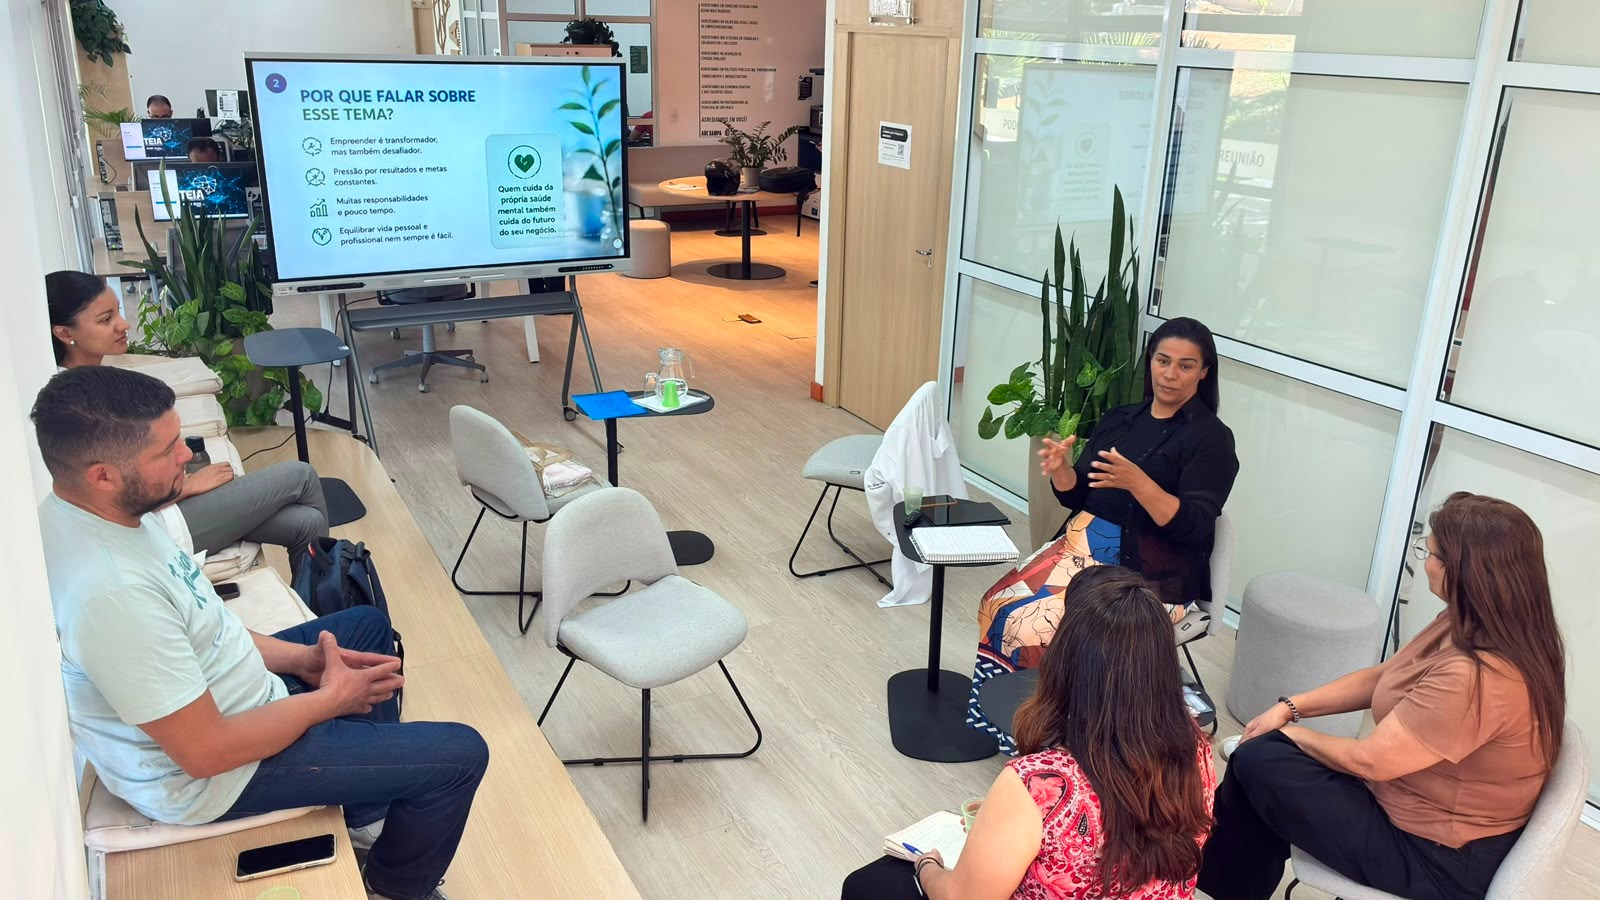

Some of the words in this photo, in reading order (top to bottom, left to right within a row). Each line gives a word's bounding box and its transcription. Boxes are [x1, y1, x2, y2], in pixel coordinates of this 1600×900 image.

[272, 79, 280, 88] 2
[300, 90, 334, 102] POR
[339, 90, 372, 104] QUE
[377, 90, 424, 102] FALAR
[429, 90, 476, 102] SOBRE
[303, 108, 339, 120] ESSE
[343, 108, 394, 120] TEMA?
[330, 137, 376, 146] Empreender
[1219, 150, 1264, 167] REUNIÃO
[333, 167, 362, 175] Pressão
[365, 168, 377, 176] por
[379, 166, 417, 174] resultados
[179, 190, 204, 200] TEIA
[363, 194, 428, 204] responsabilidades
[501, 196, 528, 205] própria
[339, 226, 374, 236] Equilibrar
[394, 223, 421, 233] pessoal
[526, 227, 556, 235] negócio.
[341, 237, 383, 246] profissional
[403, 234, 429, 242] sempre
